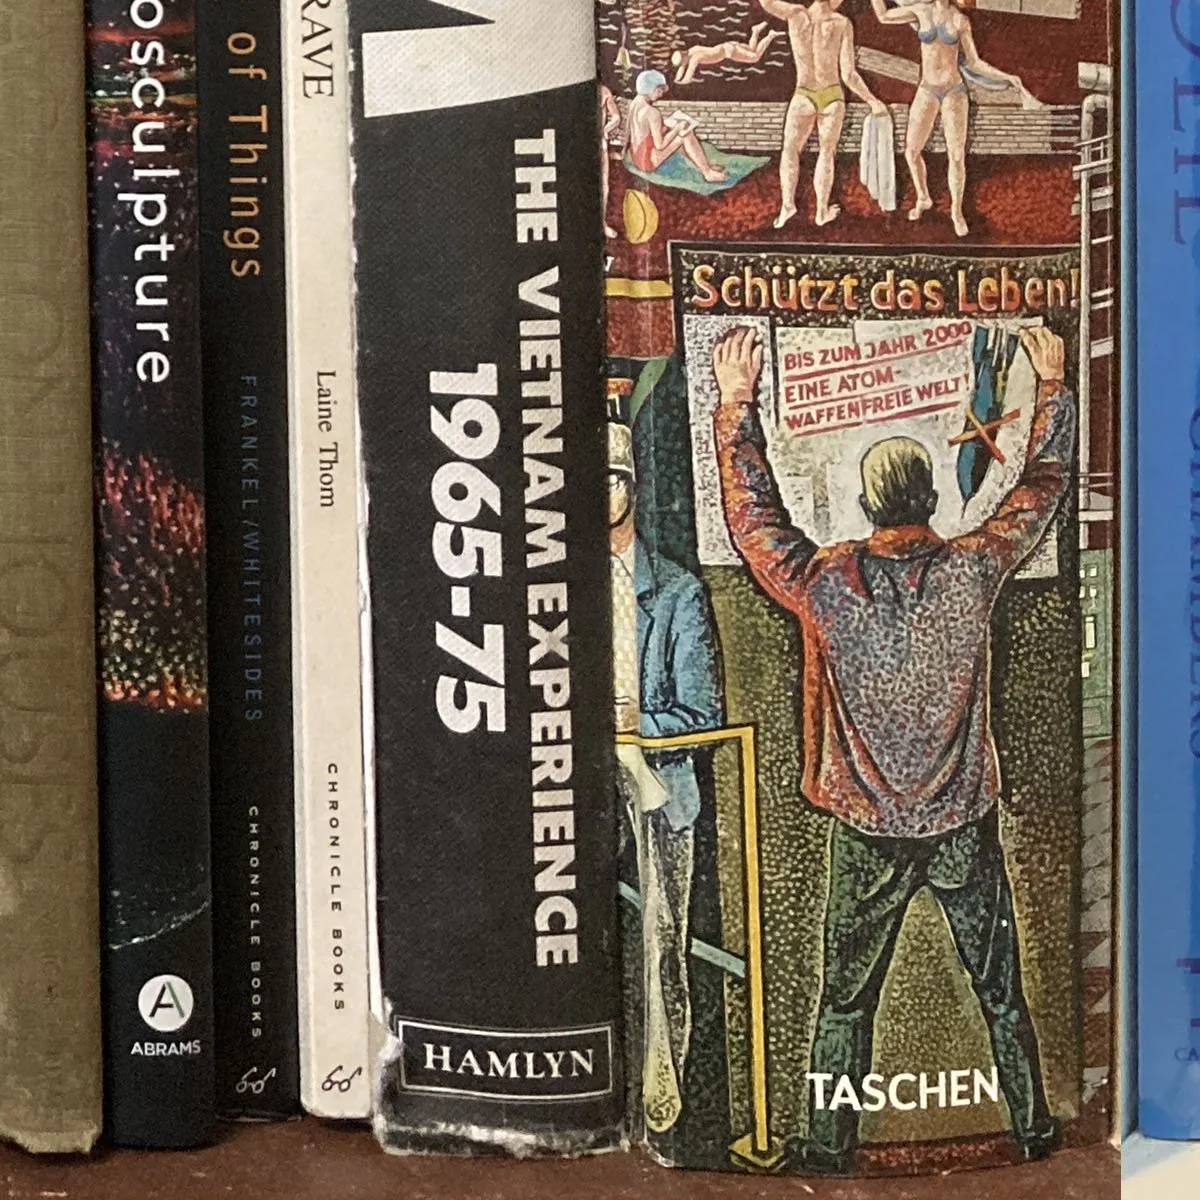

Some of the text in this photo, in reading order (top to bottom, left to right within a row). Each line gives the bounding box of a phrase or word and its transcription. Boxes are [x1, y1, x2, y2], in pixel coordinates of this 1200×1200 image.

[229, 34, 268, 81] of
[225, 106, 268, 277] Things
[691, 263, 1080, 313] Schützt das Leben!
[783, 320, 973, 371] BIS ZUM JAHR 2000
[783, 378, 832, 403] EINE
[783, 371, 971, 430] WAFFENFREIE WELT!
[318, 372, 340, 509] Laine Thom
[242, 377, 263, 721] FRANKEL/WHITESIDES
[431, 365, 506, 734] 1965-75
[516, 130, 578, 967] THE VIETNAM EXPERIENCE
[329, 764, 345, 1010] CHRONICLE BOOKS
[250, 807, 262, 1038] CHRONICLE BOOKS
[132, 1041, 201, 1057] ABRAMS
[424, 1041, 595, 1079] HAMLYN
[807, 1067, 999, 1111] TASCHEN
